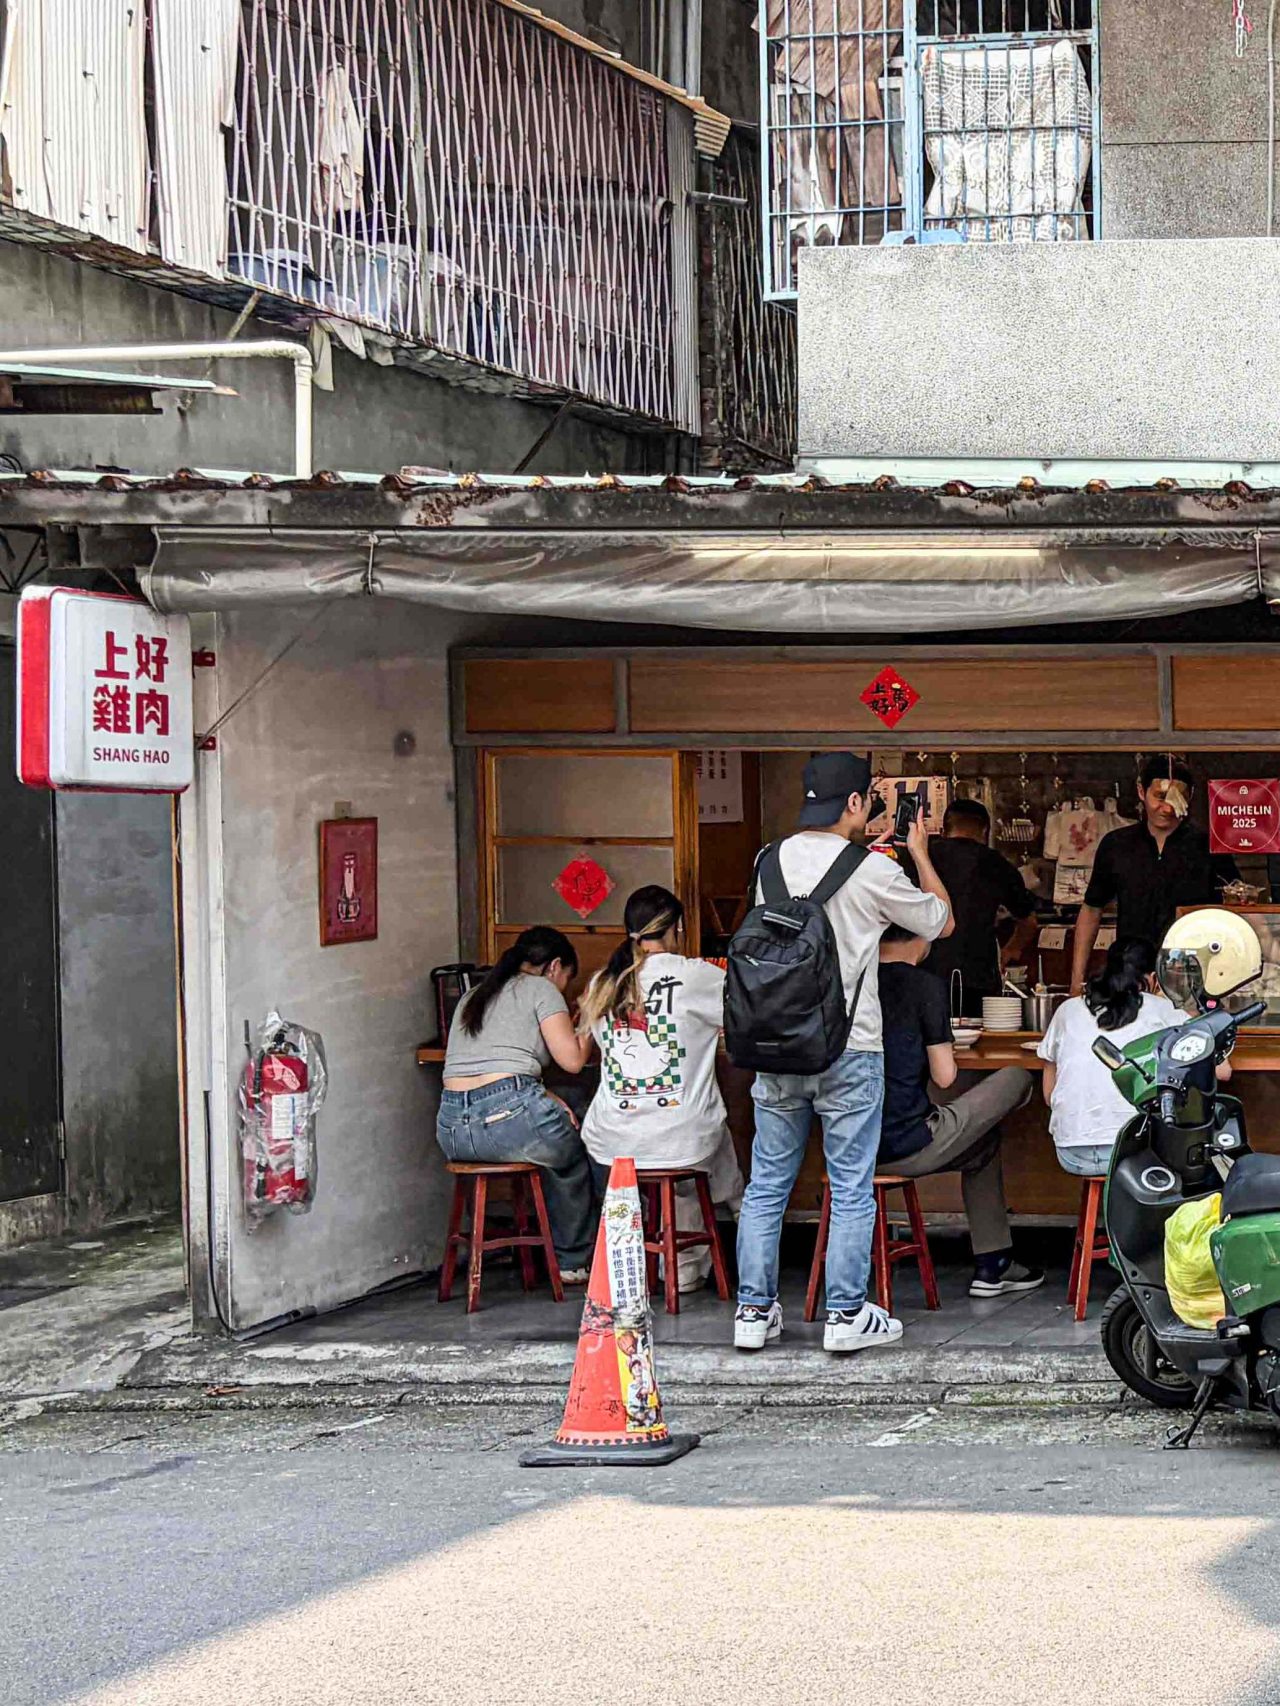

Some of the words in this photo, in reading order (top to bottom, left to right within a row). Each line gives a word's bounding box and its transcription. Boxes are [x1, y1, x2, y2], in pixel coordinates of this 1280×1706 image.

[94, 630, 169, 683] 上好
[93, 684, 169, 736] 雞肉
[93, 747, 140, 763] SHANG
[143, 750, 170, 764] HAO
[1217, 805, 1272, 816] MICHELIN
[1232, 818, 1257, 829] 2025
